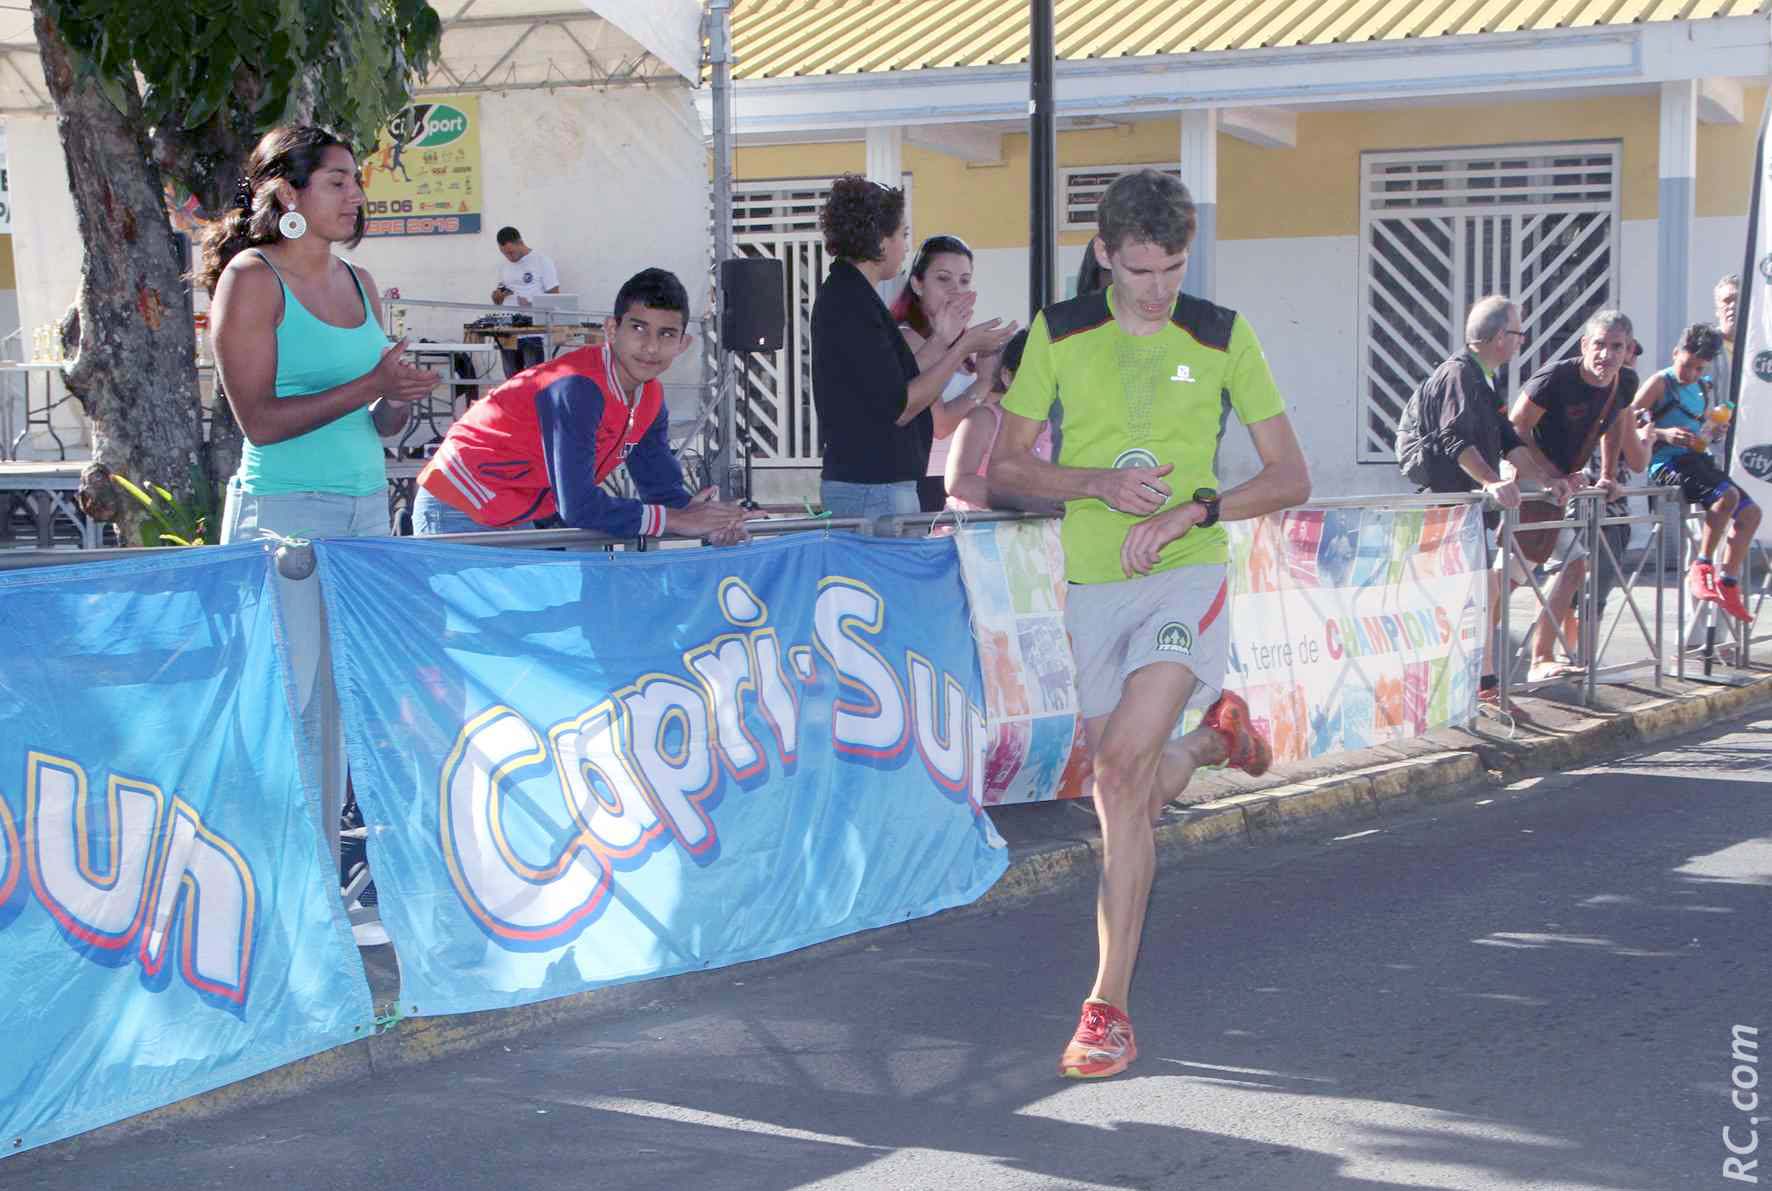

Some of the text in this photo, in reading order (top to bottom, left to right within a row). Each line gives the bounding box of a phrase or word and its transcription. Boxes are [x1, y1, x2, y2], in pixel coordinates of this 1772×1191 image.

[1252, 641, 1292, 671] terre
[1299, 634, 1320, 664] de
[1325, 605, 1451, 661] CHAMPIONS
